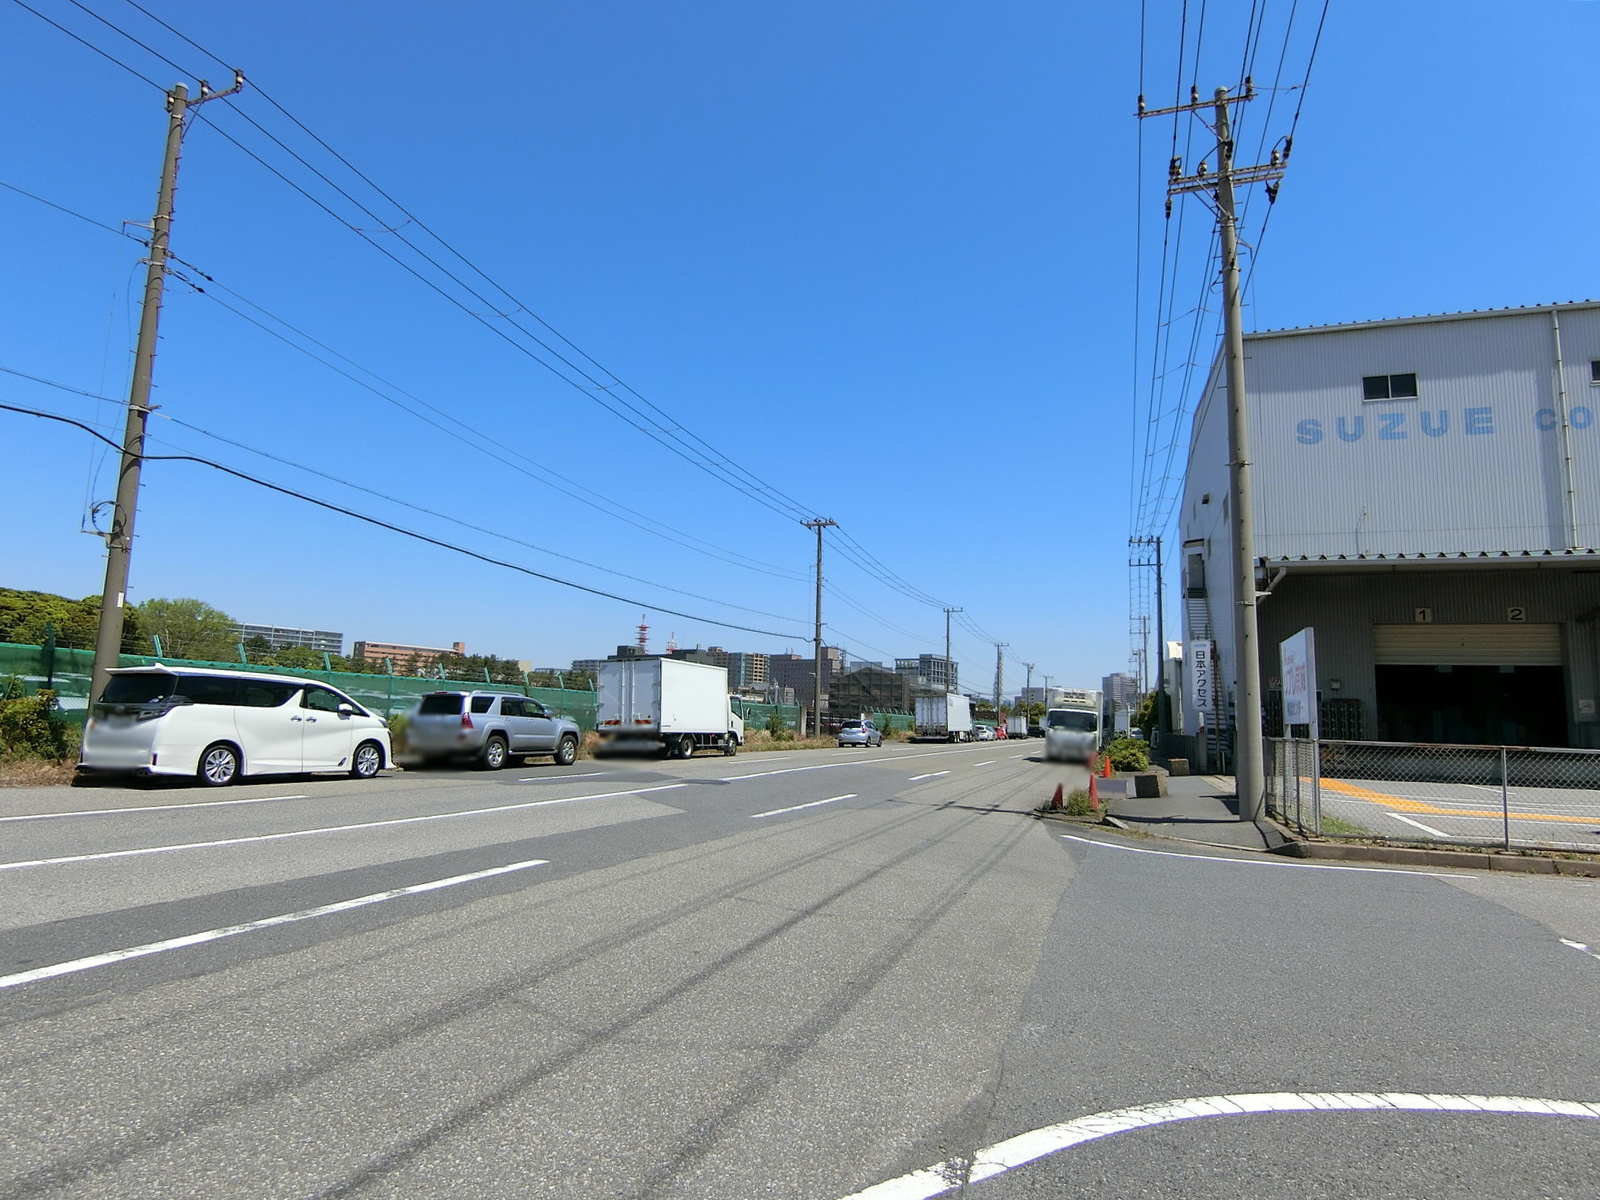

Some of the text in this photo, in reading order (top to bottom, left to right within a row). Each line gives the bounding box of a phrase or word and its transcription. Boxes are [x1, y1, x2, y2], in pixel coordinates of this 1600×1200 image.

[1296, 406, 1593, 445] SUZUE CO
[1418, 609, 1427, 621] 1
[1510, 608, 1523, 621] 2
[1195, 650, 1208, 708] 日本アクセス
